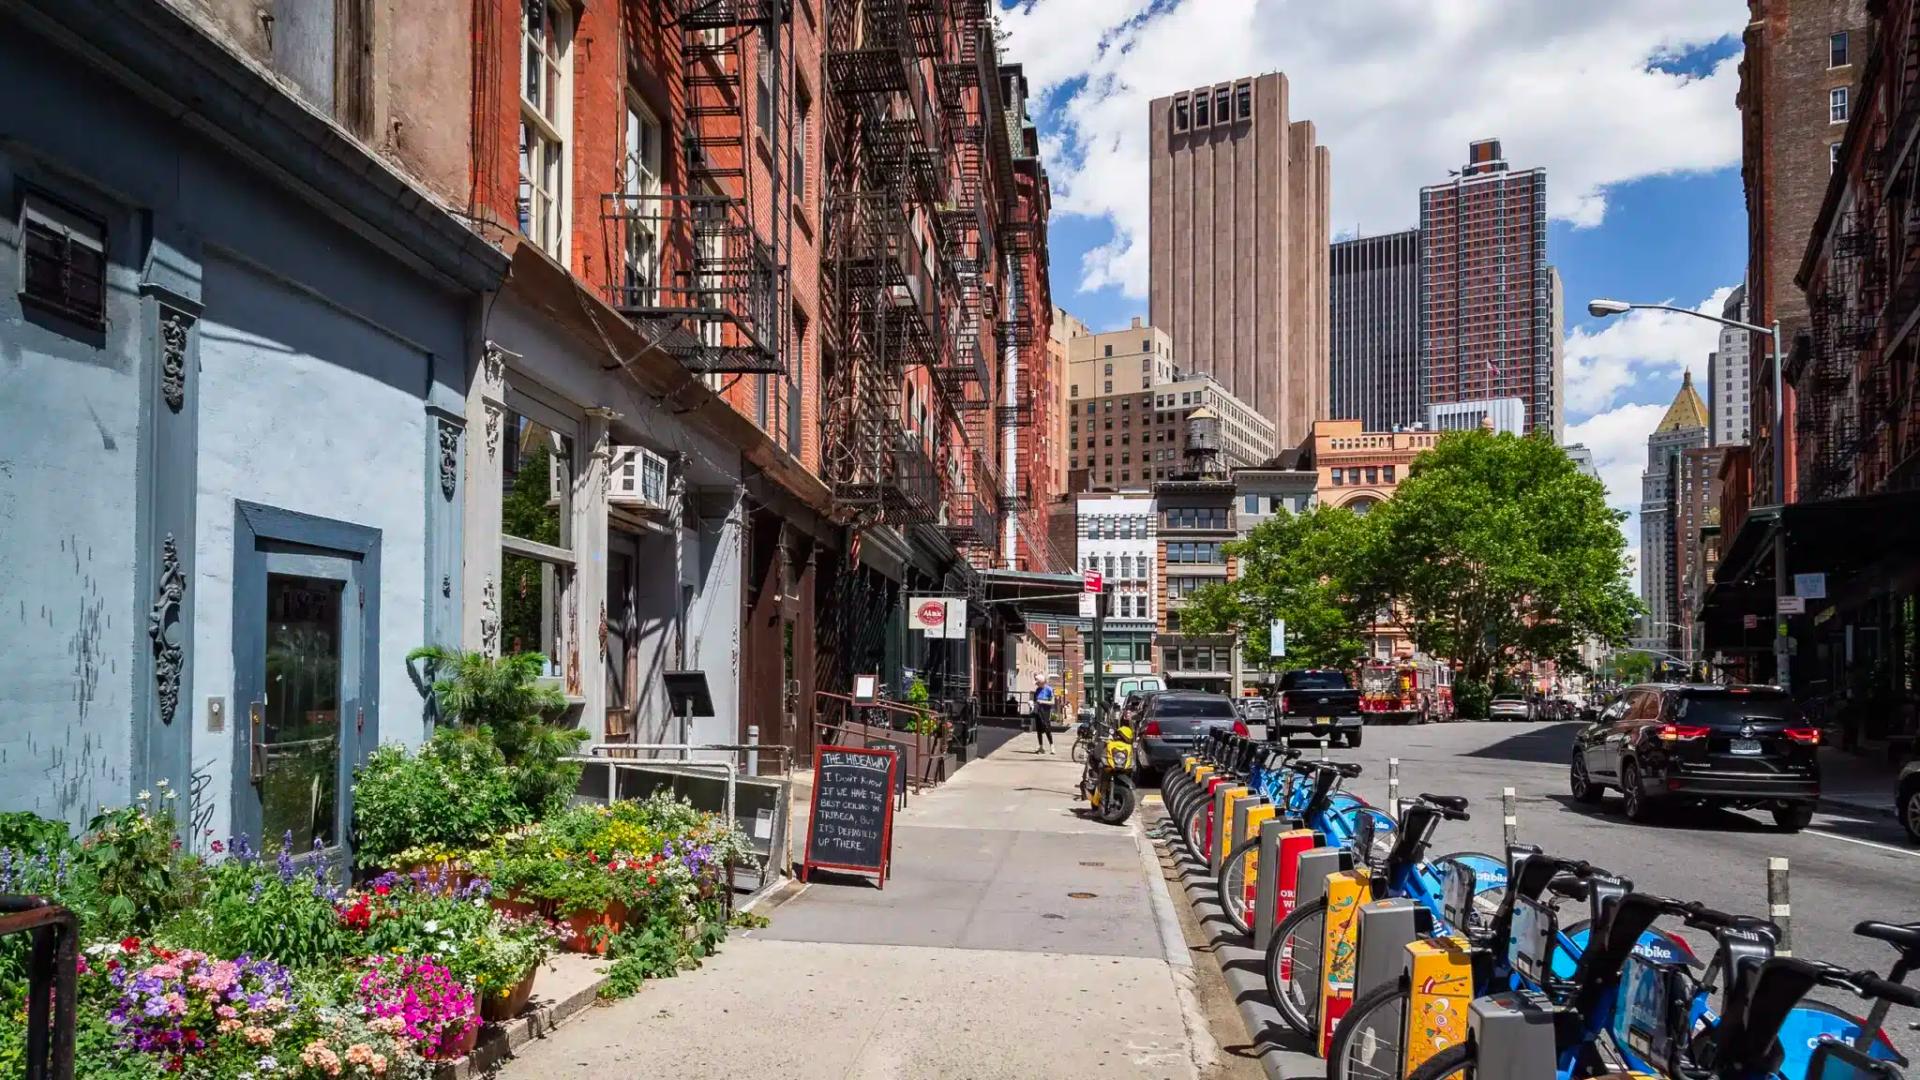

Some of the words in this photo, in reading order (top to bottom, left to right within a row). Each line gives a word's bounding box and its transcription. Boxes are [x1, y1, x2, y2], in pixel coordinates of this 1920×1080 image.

[822, 753, 844, 765] THE
[845, 754, 892, 772] HIDEAWAY
[824, 772, 832, 782] I
[822, 787, 835, 796] IF
[836, 787, 848, 796] WE
[851, 789, 867, 799] HAVE
[869, 791, 882, 802] THE
[820, 799, 840, 808] BEST
[818, 837, 830, 847] UP
